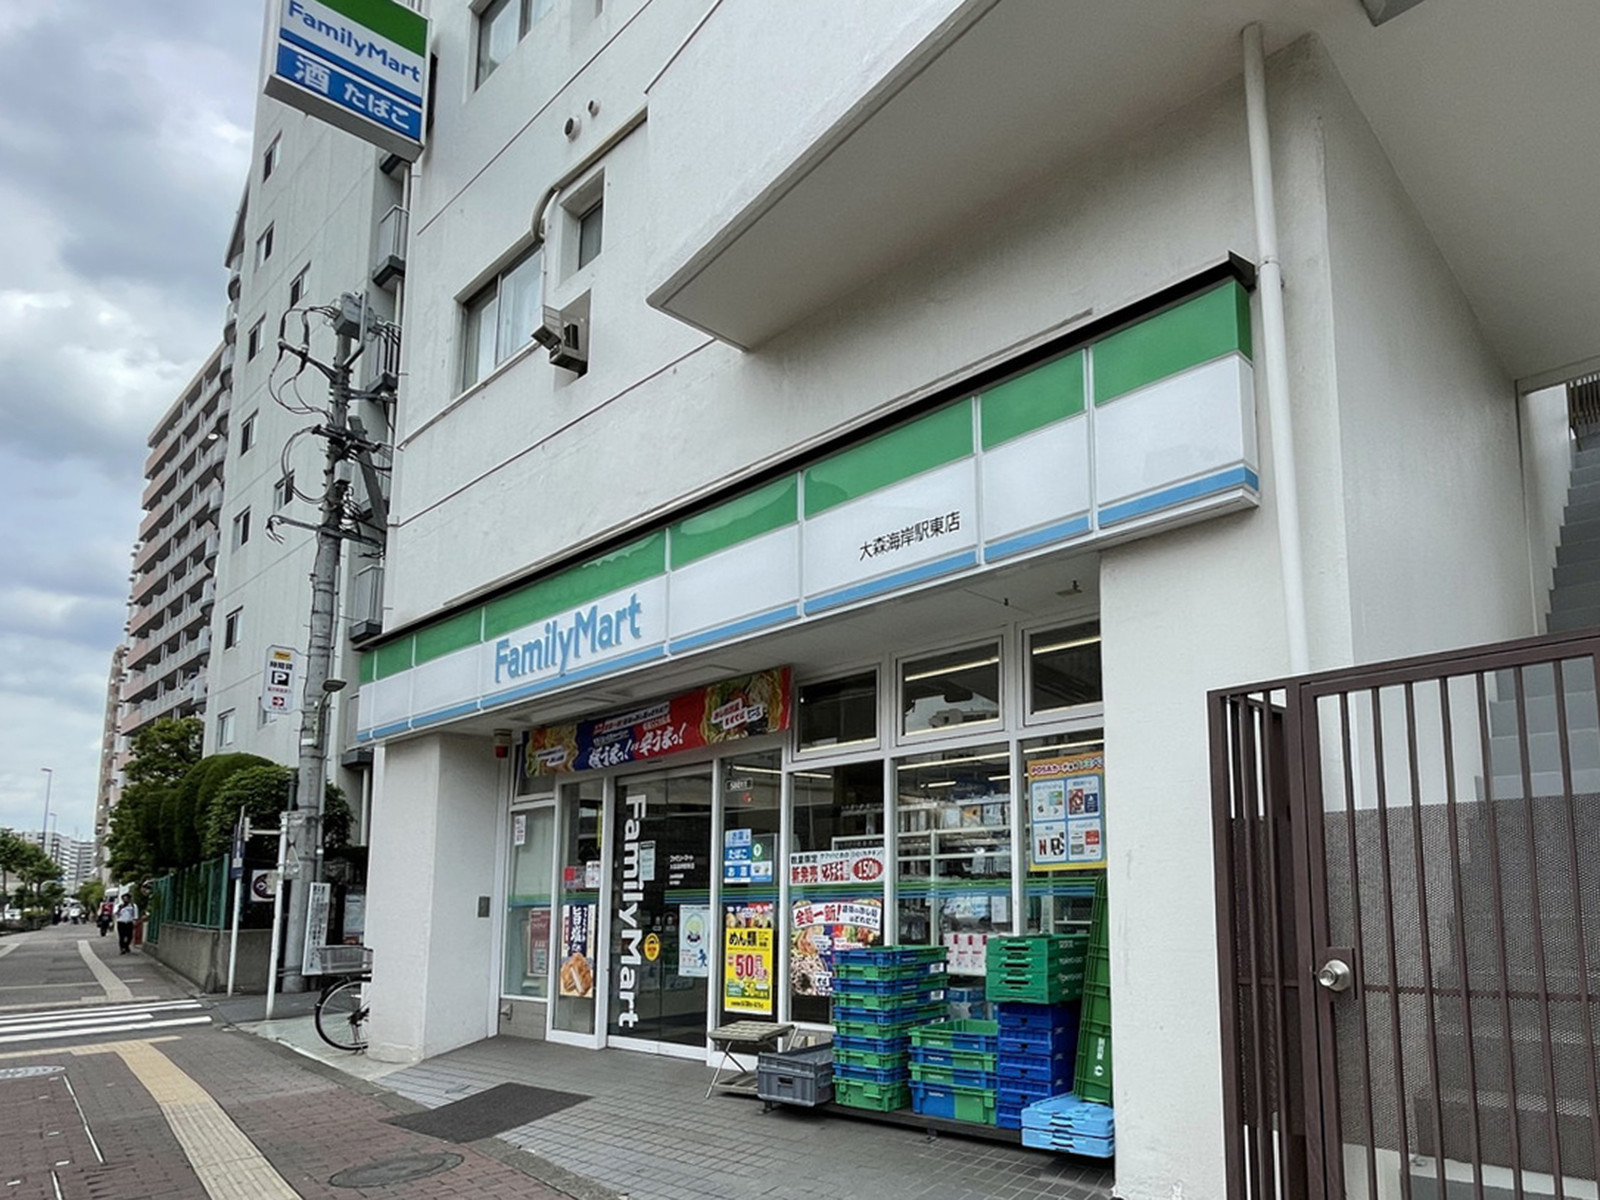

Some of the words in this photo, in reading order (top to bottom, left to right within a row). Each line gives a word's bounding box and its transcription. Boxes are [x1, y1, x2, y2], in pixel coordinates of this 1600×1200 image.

[288, 1, 420, 82] FamilyMart
[295, 54, 331, 94] 酒
[344, 83, 410, 130] たばこ
[859, 511, 960, 561] 大森海岸駅東店
[495, 593, 642, 683] FamilyMart
[618, 794, 647, 1028] FamilyMart
